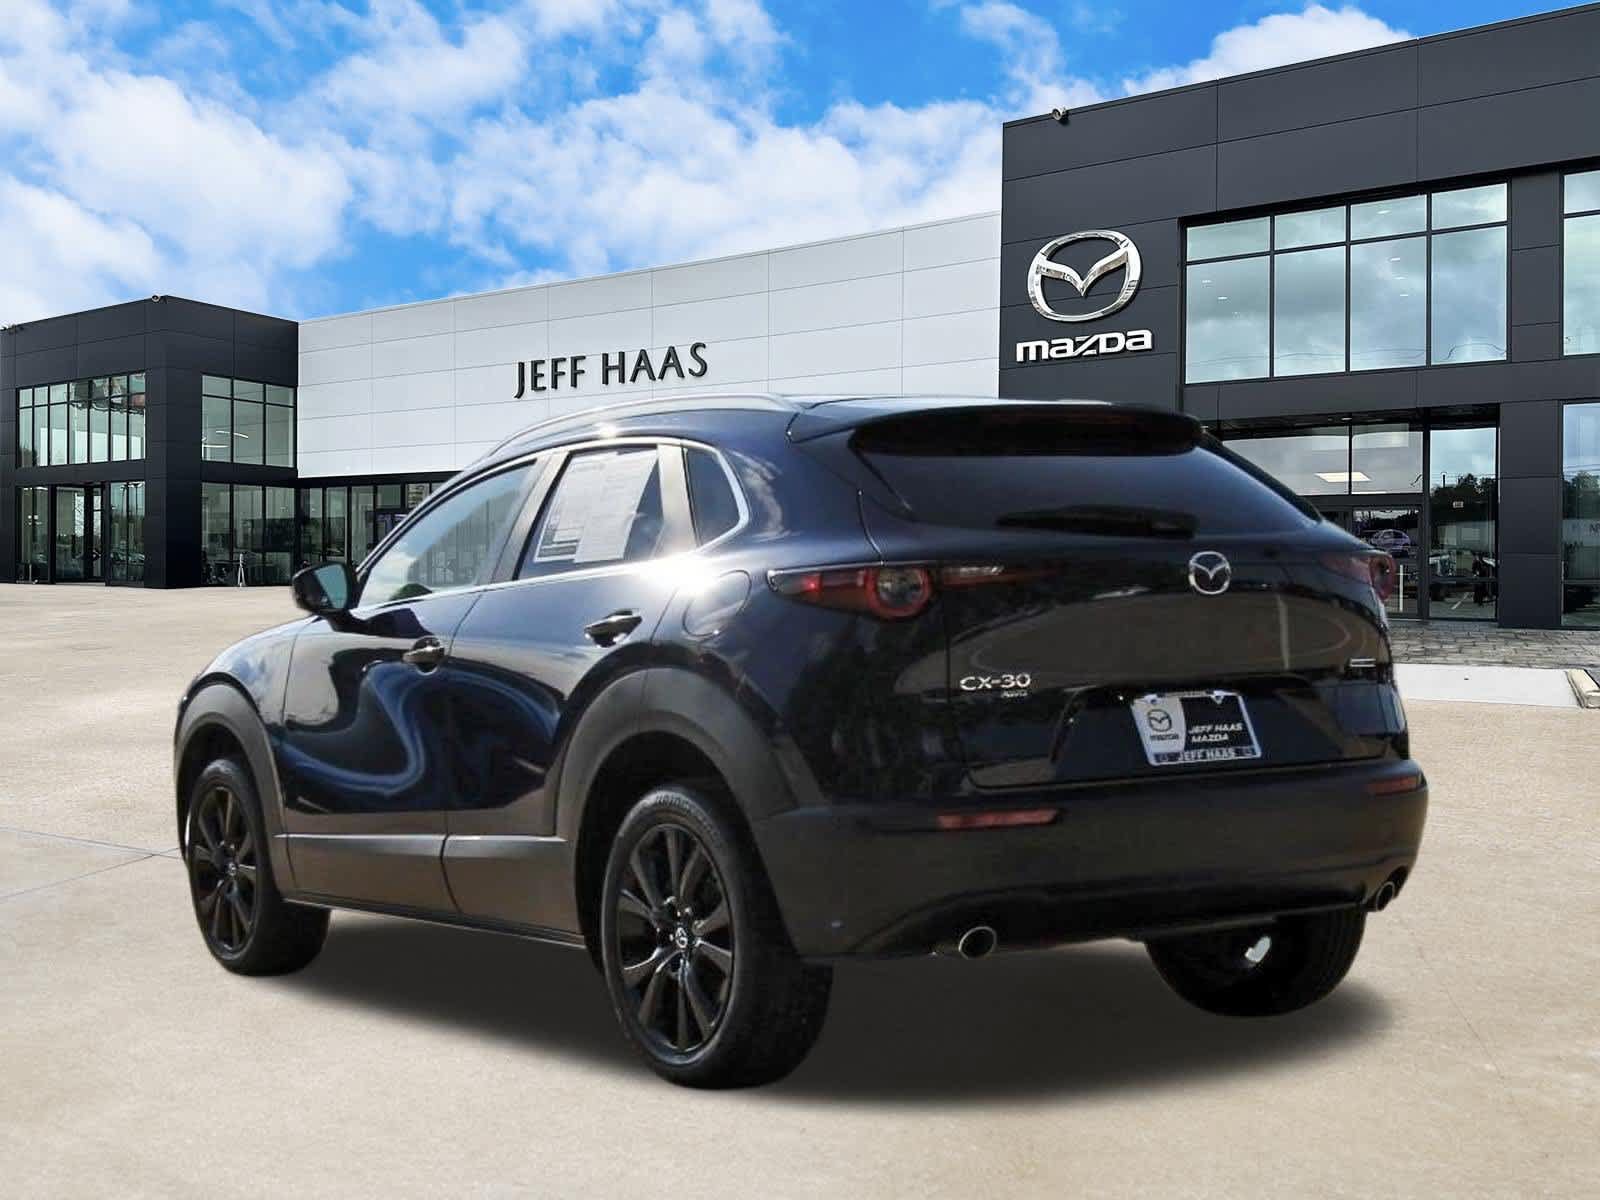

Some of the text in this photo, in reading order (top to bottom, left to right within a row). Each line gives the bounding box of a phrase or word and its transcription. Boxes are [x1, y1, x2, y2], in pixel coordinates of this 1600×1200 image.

[513, 341, 708, 399] JEFF HAAS
[959, 673, 1031, 691] CX-30
[1188, 722, 1243, 734] JEFF HAAS
[1191, 733, 1229, 743] MAZDA
[1206, 747, 1236, 760] HAAS
